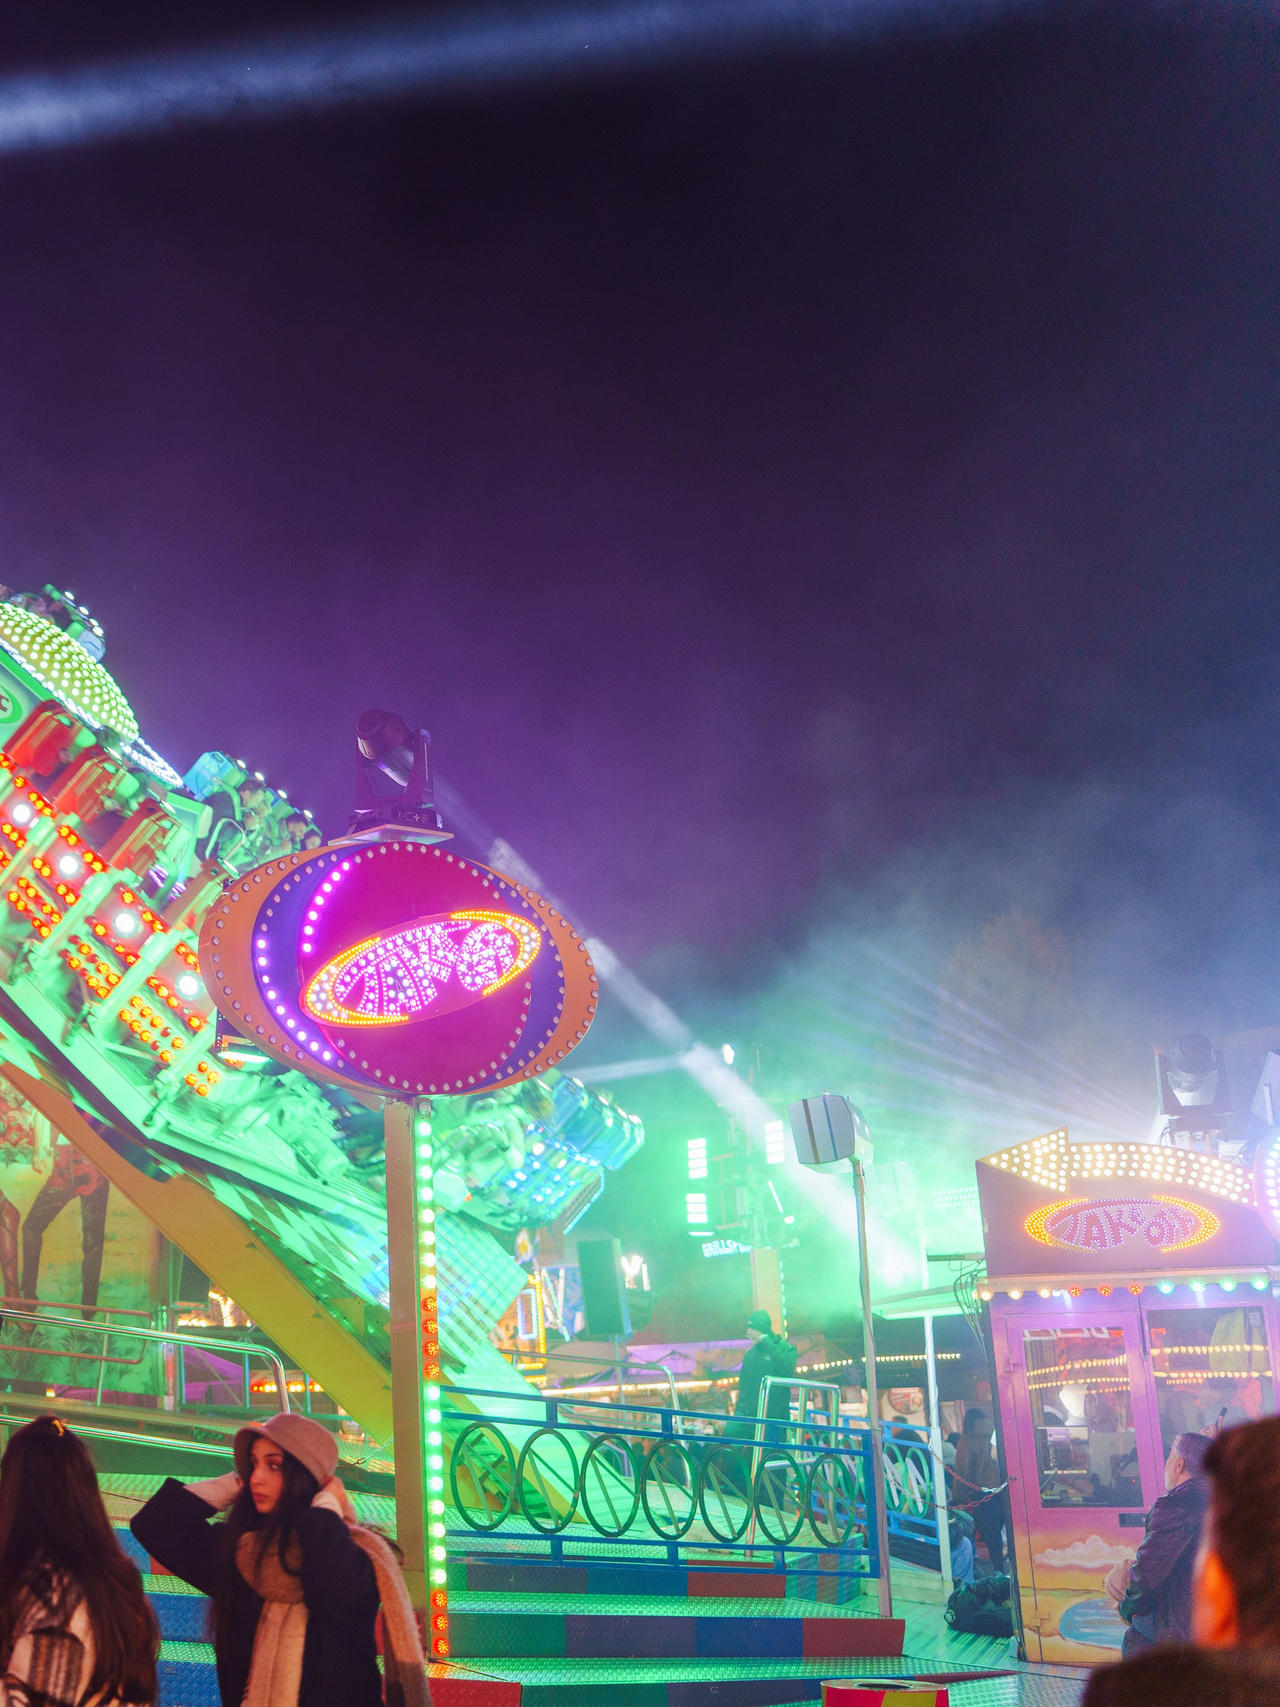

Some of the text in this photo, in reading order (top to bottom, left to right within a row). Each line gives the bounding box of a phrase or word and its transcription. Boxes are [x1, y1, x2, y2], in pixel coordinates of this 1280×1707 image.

[333, 920, 514, 1016] TAKE OFF
[1045, 1198, 1195, 1250] TAKE OFF
